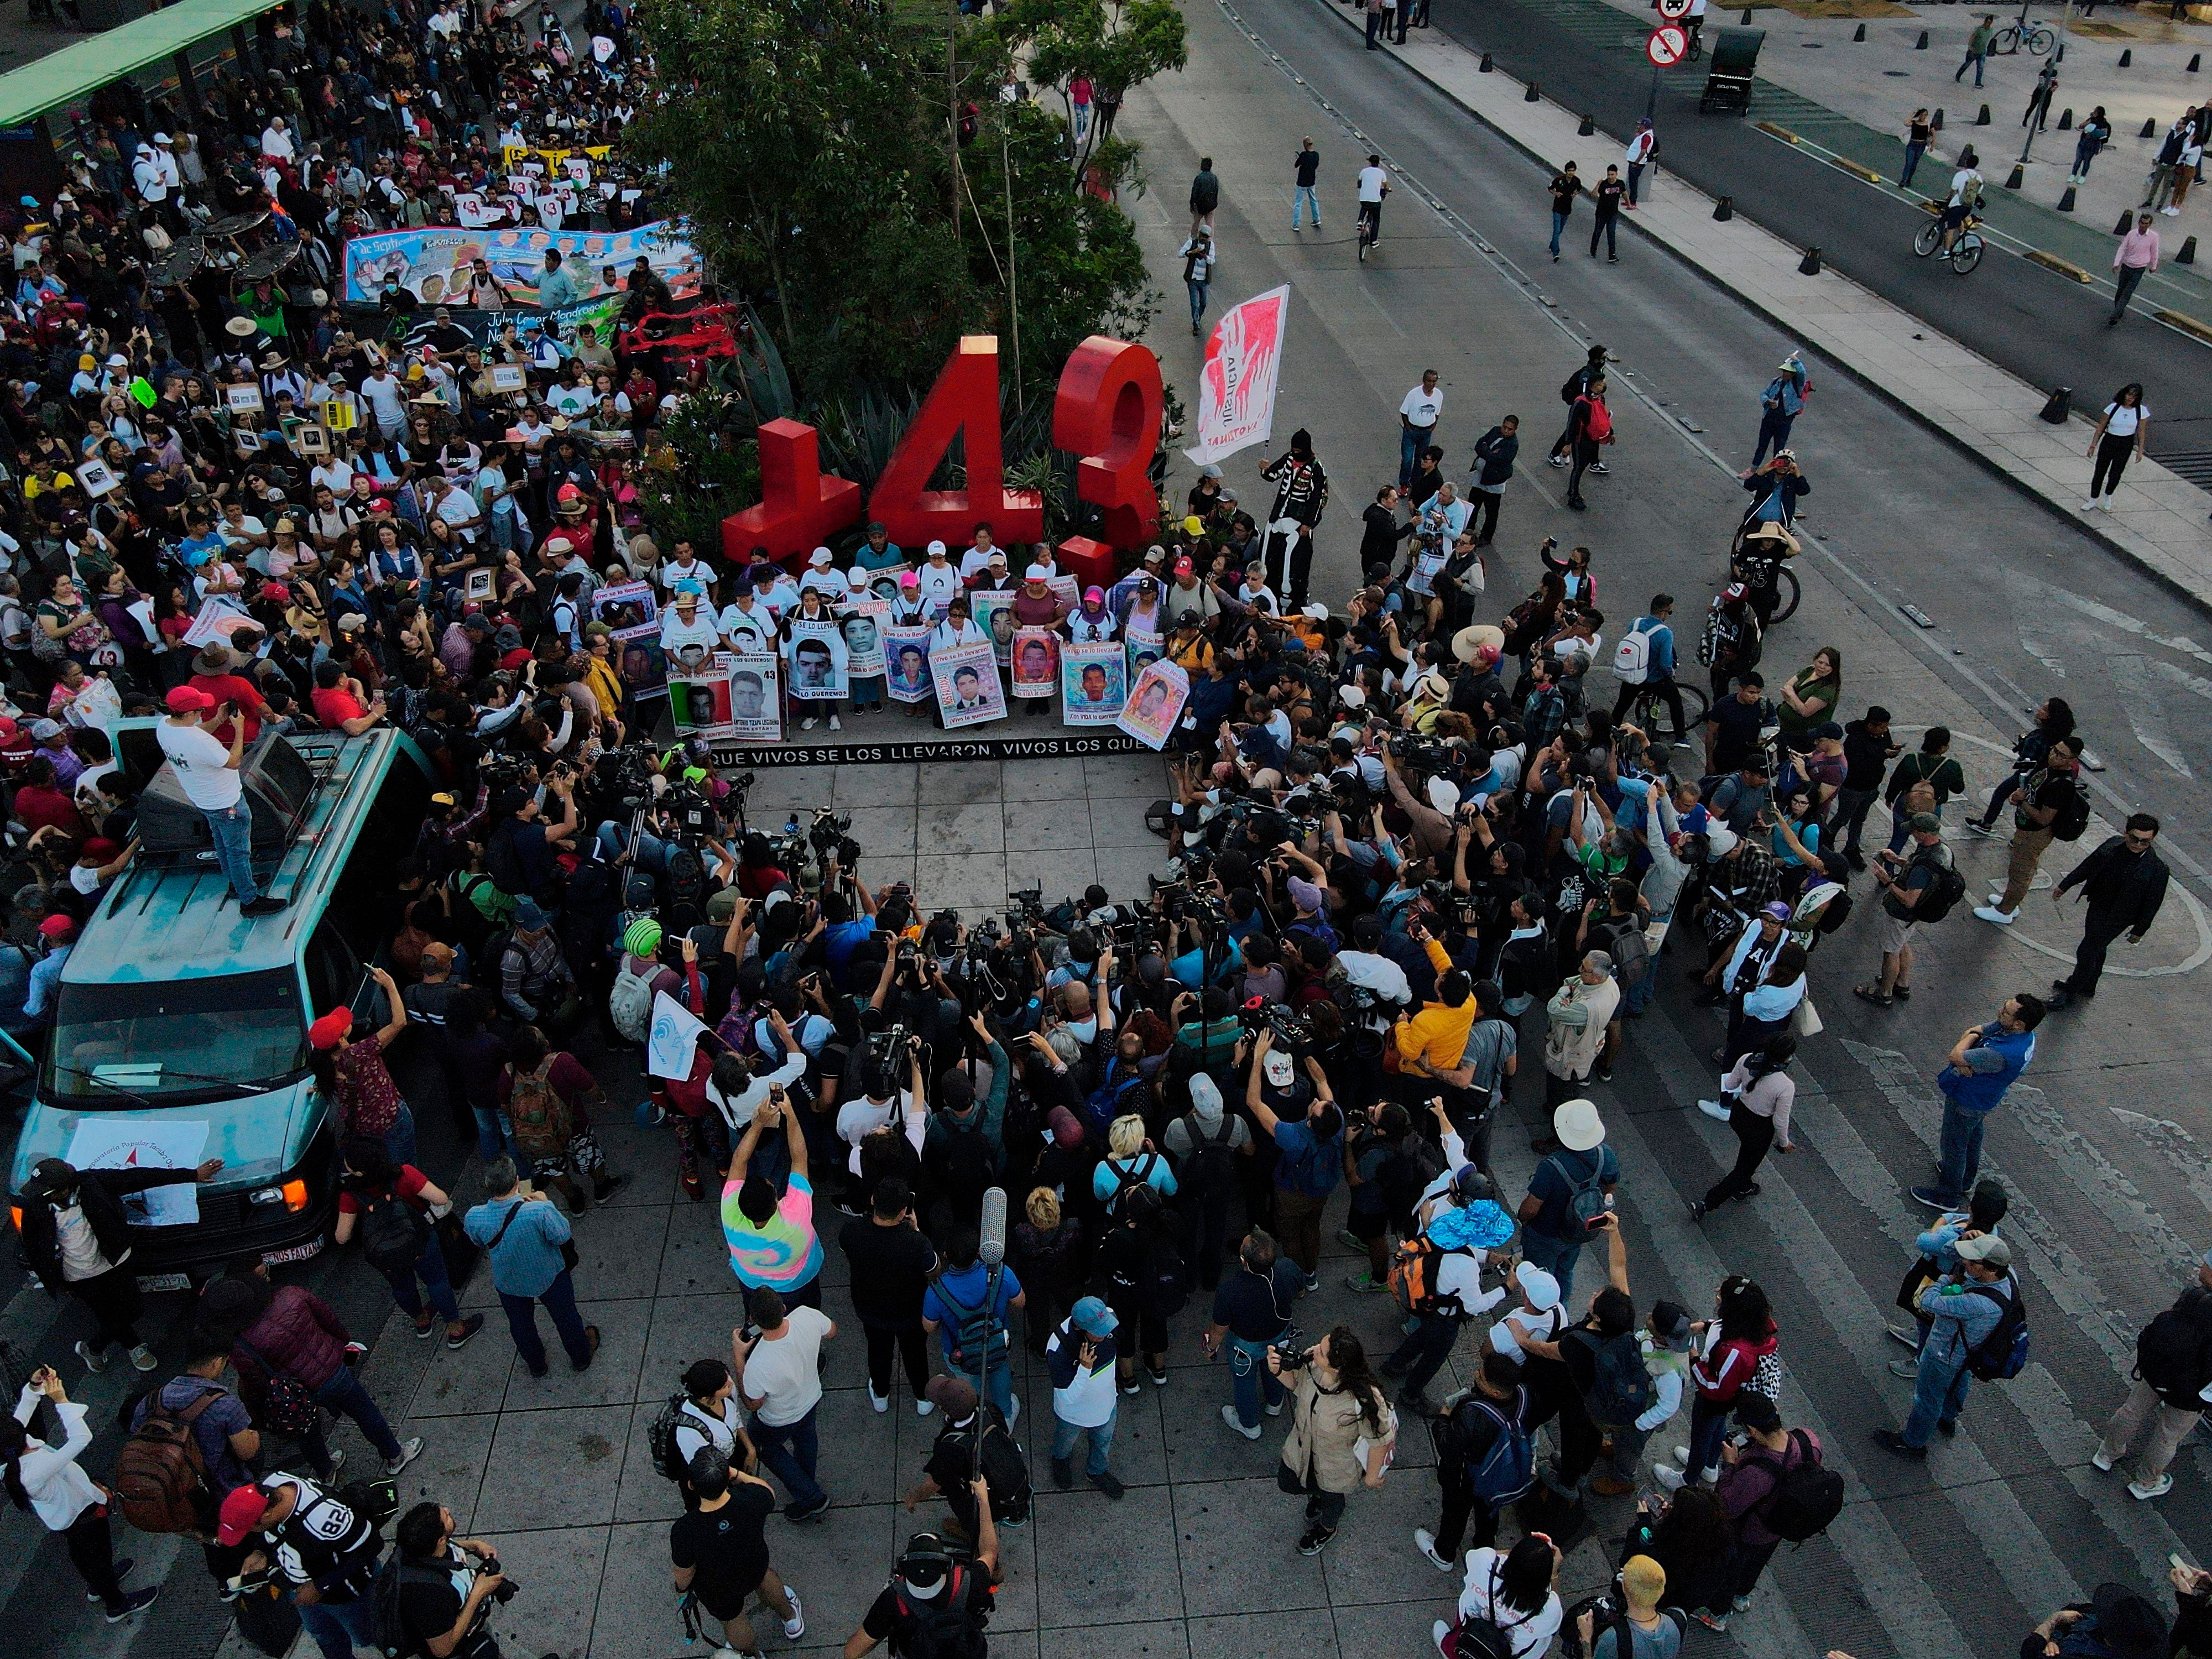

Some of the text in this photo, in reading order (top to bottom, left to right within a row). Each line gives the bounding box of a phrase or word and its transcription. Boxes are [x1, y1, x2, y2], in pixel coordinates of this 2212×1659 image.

[964, 646, 989, 657] llevaron!
[764, 670, 775, 679] 43
[752, 750, 809, 764] VIVOS
[816, 749, 838, 761] SE
[846, 748, 881, 761] LOS
[1003, 742, 1058, 755] VIVOS
[1066, 740, 1100, 753] LOS
[149, 1142, 168, 1159] Tacuba
[273, 1250, 289, 1261] NOS
[290, 1241, 318, 1259] FALTAN
[321, 1509, 348, 1535] 82
[1471, 1583, 1503, 1609] TOKO
